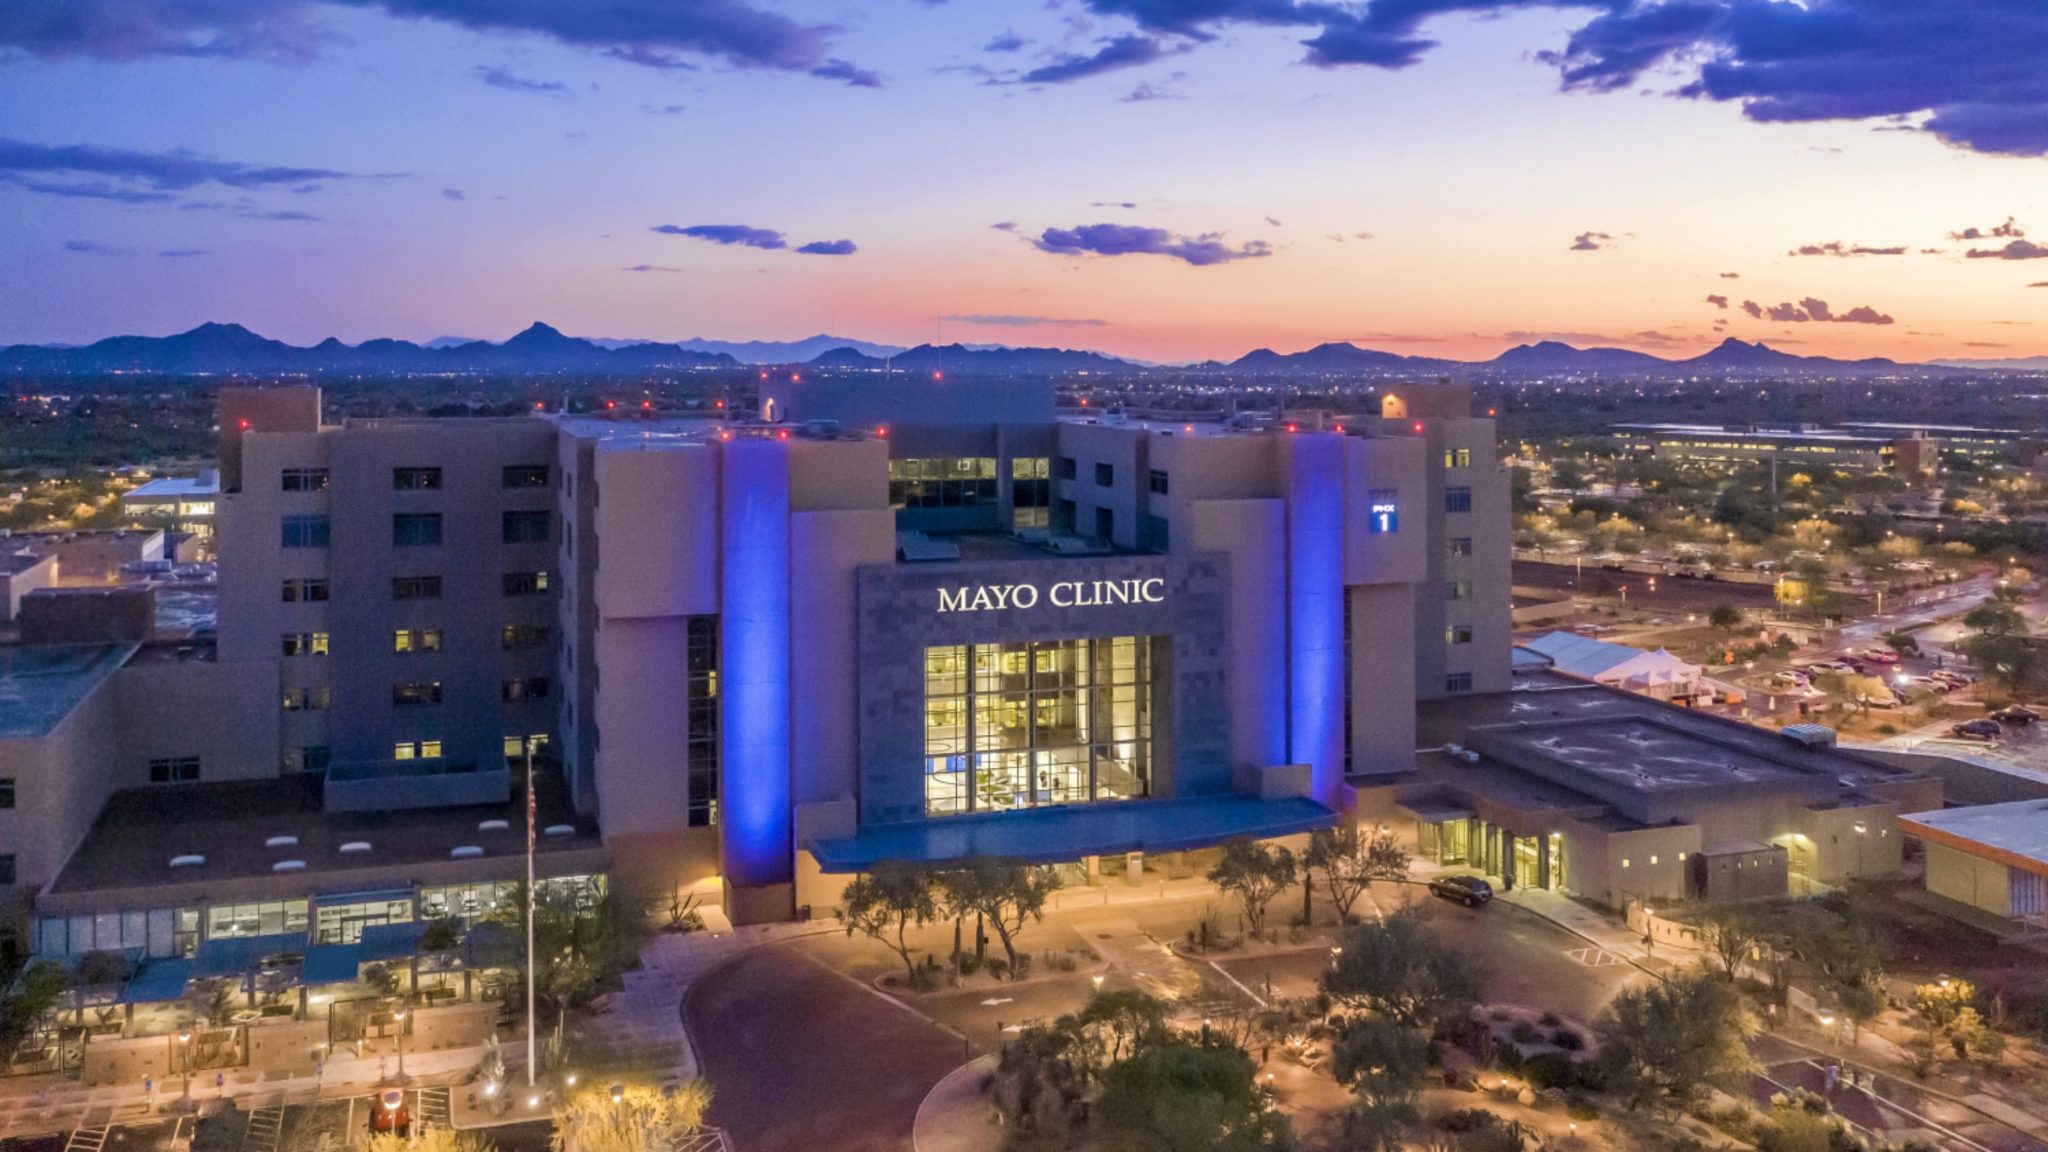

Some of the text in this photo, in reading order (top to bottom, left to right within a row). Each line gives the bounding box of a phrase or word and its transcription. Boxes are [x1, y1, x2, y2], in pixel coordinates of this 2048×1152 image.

[1380, 513, 1388, 531] 1
[936, 578, 1165, 613] MAYO CLINIC
